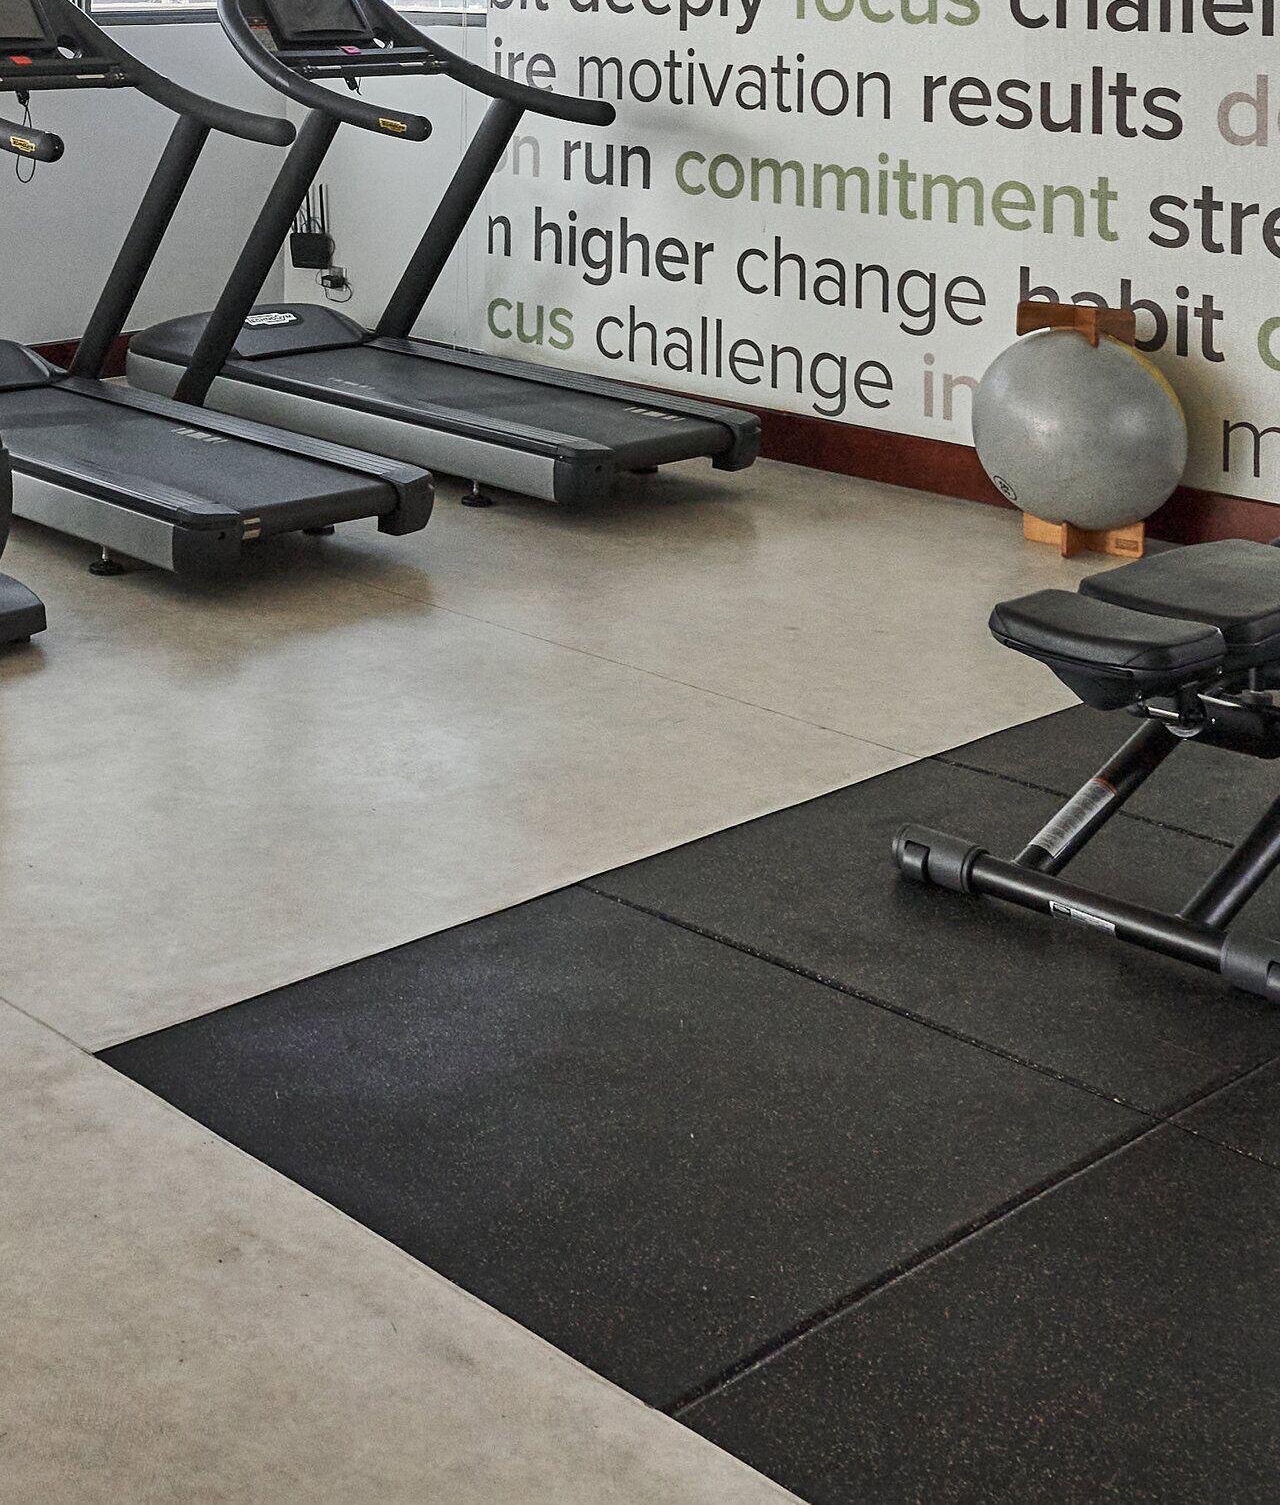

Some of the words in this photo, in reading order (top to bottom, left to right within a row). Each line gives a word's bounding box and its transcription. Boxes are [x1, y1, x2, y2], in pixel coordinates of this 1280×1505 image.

[494, 37, 556, 91] ire
[579, 48, 890, 119] motivation
[924, 66, 1183, 140] results
[564, 140, 651, 189] run
[675, 150, 1119, 242] commitment
[534, 206, 714, 286] higher
[737, 236, 986, 336] change
[487, 297, 574, 350] cus
[596, 305, 893, 416] challenge
